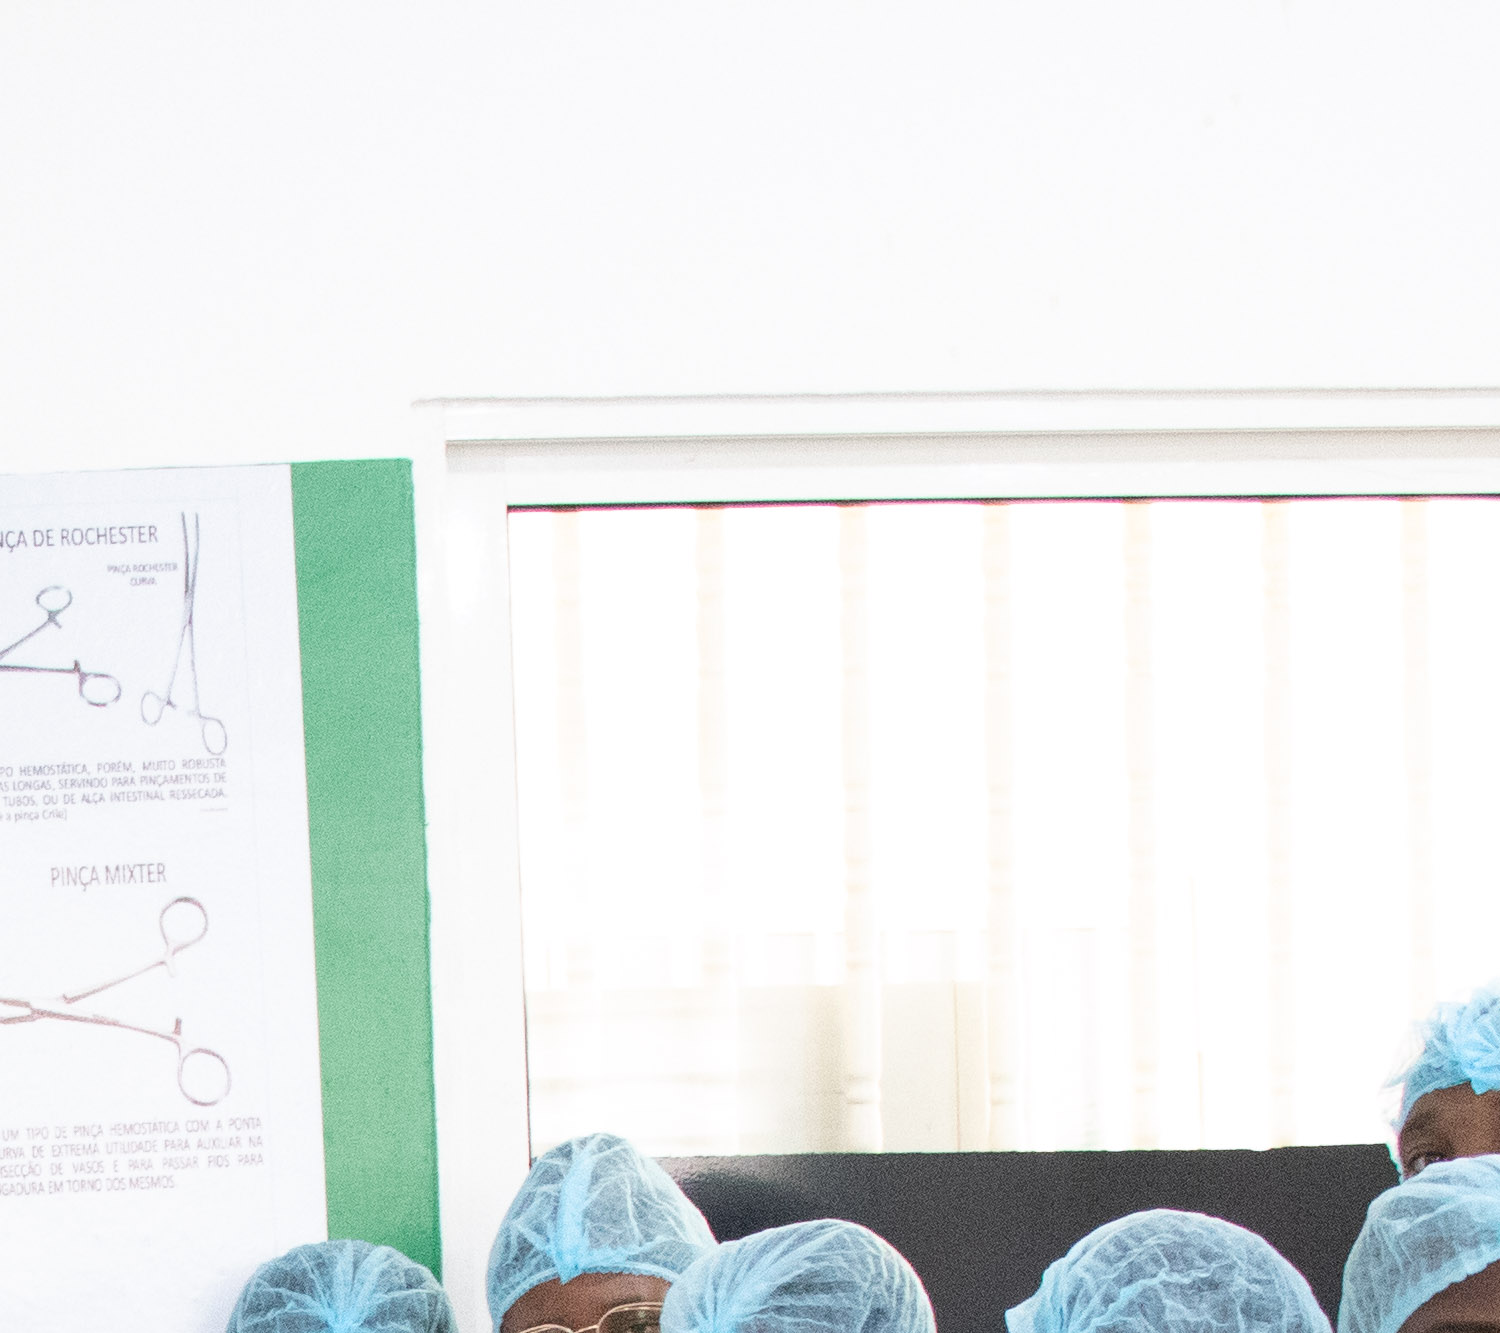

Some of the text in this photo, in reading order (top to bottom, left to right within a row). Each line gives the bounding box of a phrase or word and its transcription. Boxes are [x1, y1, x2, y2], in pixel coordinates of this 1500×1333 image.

[33, 529, 54, 548] DE
[60, 525, 158, 546] ROCHESTER
[142, 758, 175, 772] MUITO
[182, 757, 226, 770] ROBUSTA
[58, 776, 108, 790] SERVINDO
[111, 775, 136, 789] PARA
[140, 773, 210, 789] PINÇAMENTOS
[213, 772, 227, 785] DE
[43, 793, 58, 806] OU
[63, 793, 76, 806] DE
[82, 791, 105, 806] ALÇA
[110, 789, 165, 803] INTESTINAL
[50, 862, 167, 892] PINÇA MIXTER
[2, 1128, 19, 1142] UM
[26, 1127, 49, 1141] TIPO
[55, 1126, 68, 1139] DE
[73, 1124, 104, 1140] PINÇA
[185, 1120, 209, 1134] COM
[228, 1117, 262, 1130] PONTA
[32, 1145, 44, 1159] DE
[51, 1143, 100, 1157] EXTREMA
[106, 1140, 158, 1155] UTILIDADE
[164, 1138, 190, 1151] PARA
[249, 1135, 263, 1147] NA
[50, 1153, 264, 1176] DE VASOS PARA PASSAR FIOS PARA
[49, 1180, 64, 1194] EM
[66, 1178, 102, 1193] TORNO
[106, 1177, 126, 1191] DOS
